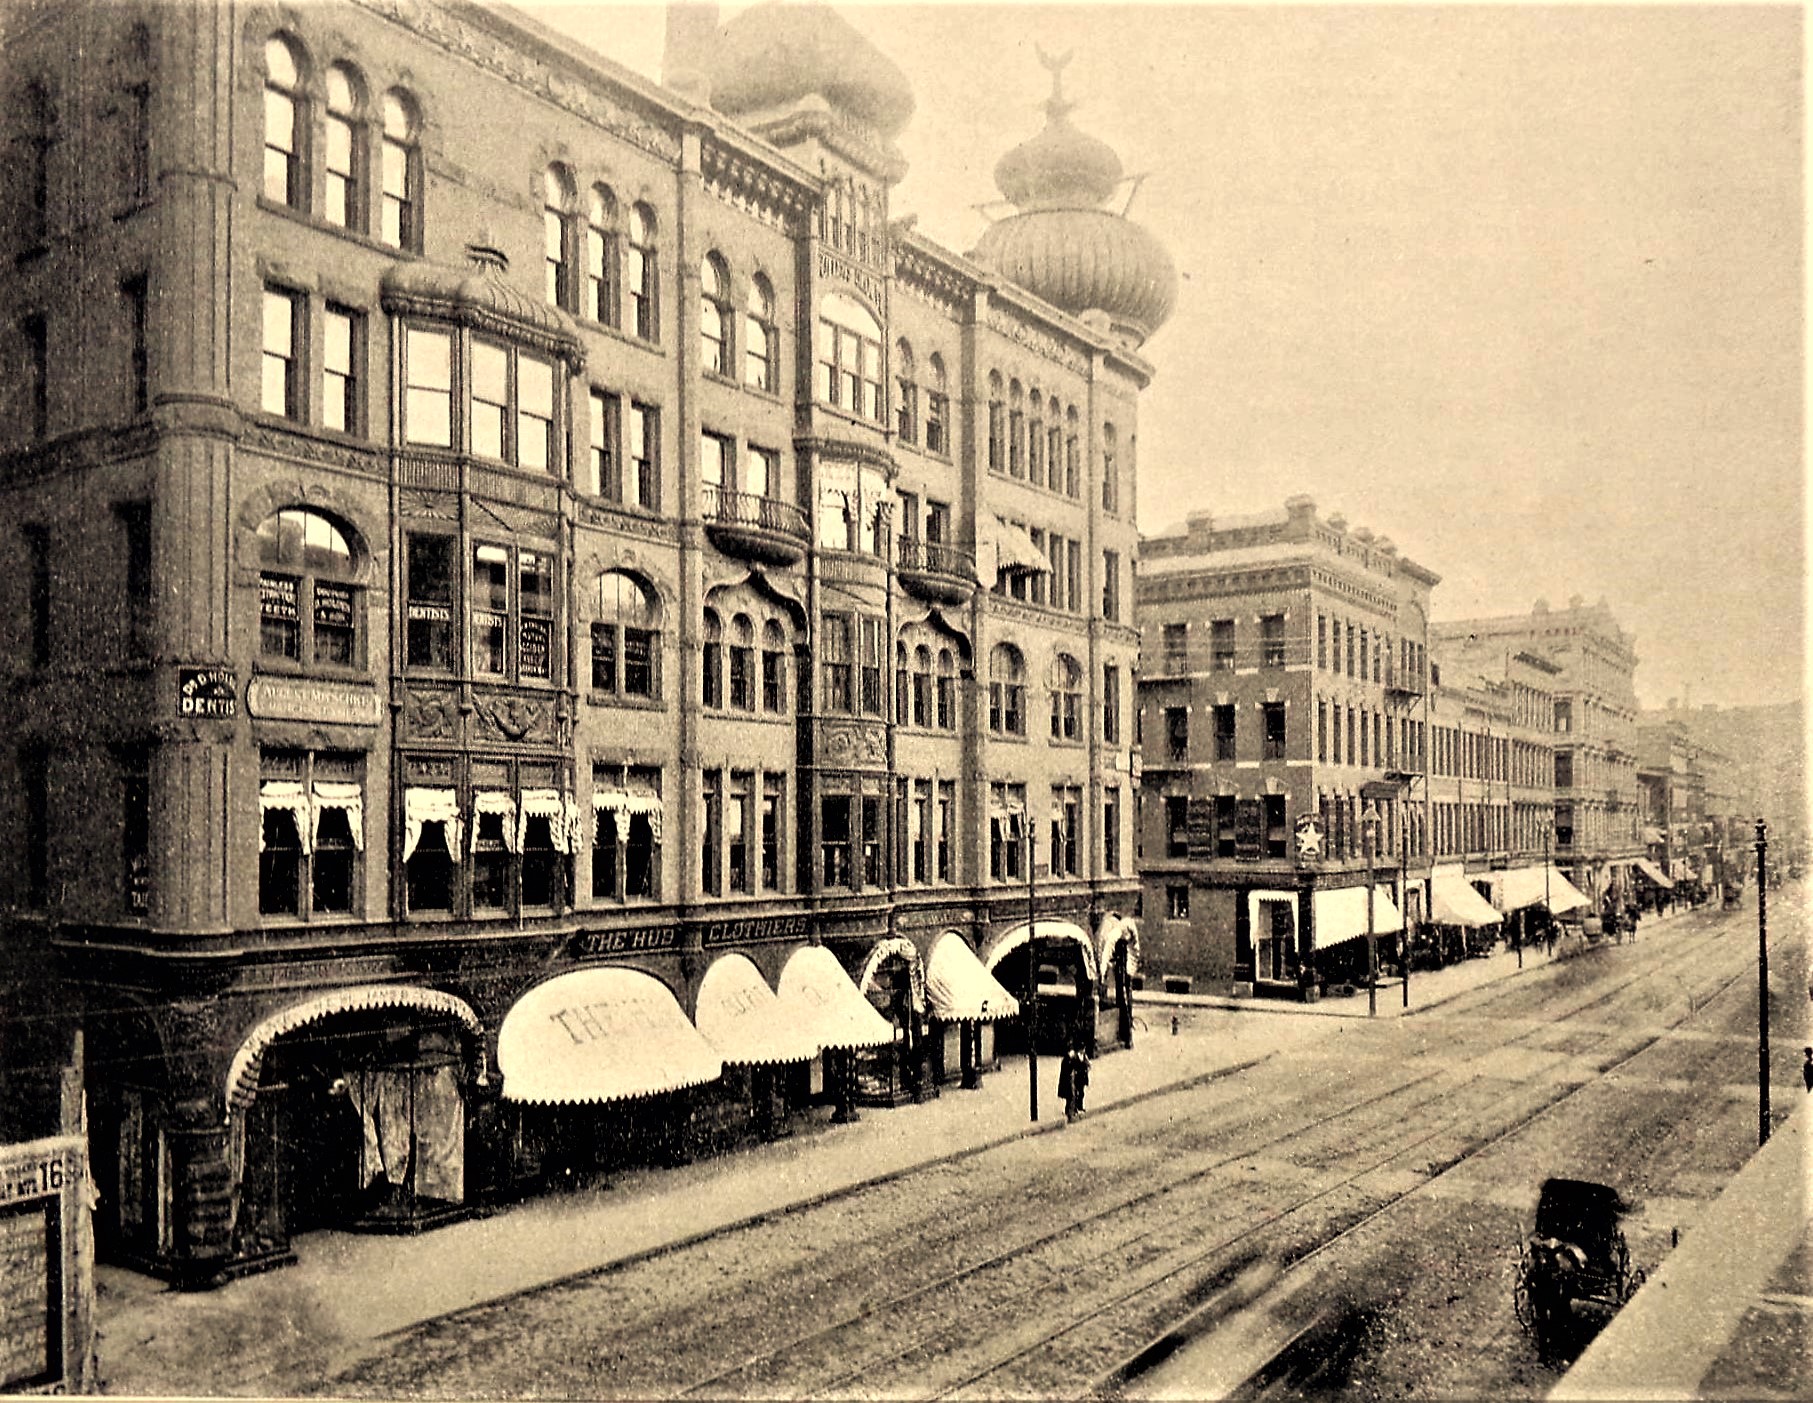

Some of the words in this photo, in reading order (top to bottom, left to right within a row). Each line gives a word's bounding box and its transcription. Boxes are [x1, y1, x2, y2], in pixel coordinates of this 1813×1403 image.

[586, 930, 629, 951] THE
[630, 927, 676, 949] HUB
[707, 917, 809, 942] CLOTHIERS
